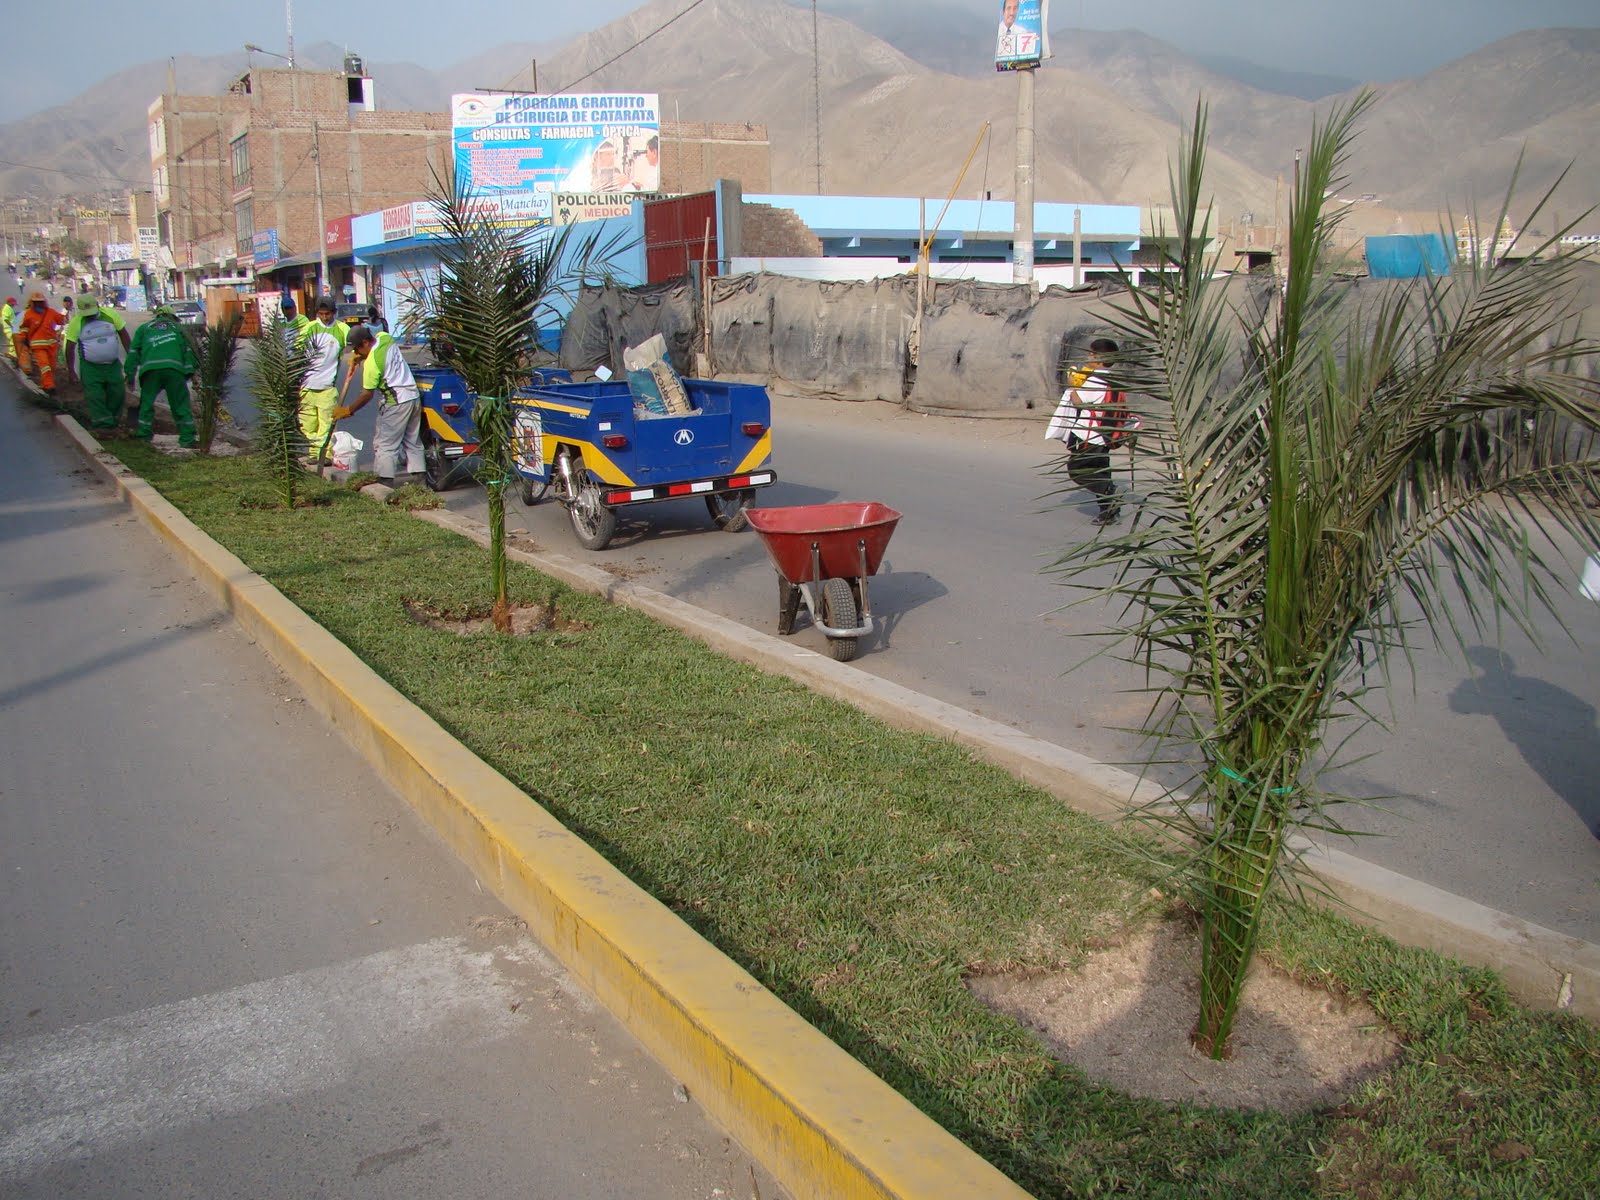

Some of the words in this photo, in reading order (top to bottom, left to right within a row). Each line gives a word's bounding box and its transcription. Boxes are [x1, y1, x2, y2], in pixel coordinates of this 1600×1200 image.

[504, 97, 578, 109] PROGRAMA
[581, 96, 645, 108] GRATUITO
[496, 111, 511, 123] DE
[514, 110, 569, 123] CIRUGIA
[571, 111, 588, 122] DE
[591, 110, 655, 121] CATARATA
[472, 128, 531, 141] CONSULTAS
[541, 126, 594, 139] FARMACIA
[502, 194, 549, 211] Manchay
[584, 207, 630, 218] MEDICO
